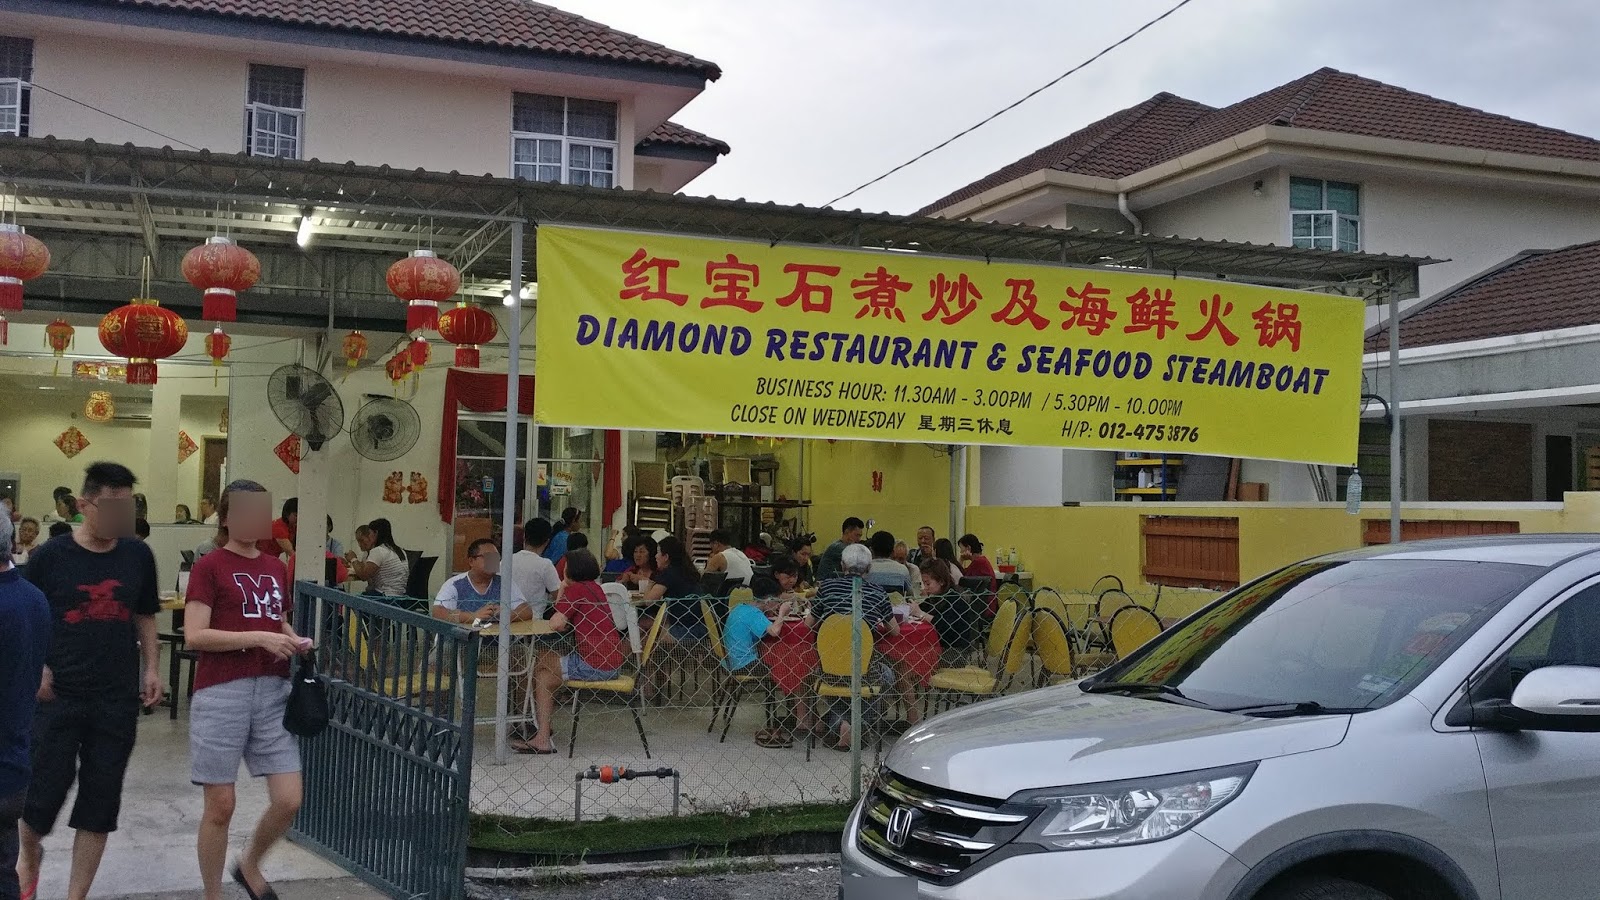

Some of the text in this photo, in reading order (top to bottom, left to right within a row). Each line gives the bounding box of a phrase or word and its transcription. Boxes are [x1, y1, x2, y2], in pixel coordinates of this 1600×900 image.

[620, 249, 1302, 352] 红宝石煮炒及海鲜火锅
[576, 315, 1330, 395] DIAMOND RESTAURANT & SEAFOOD STEAMBOAT
[756, 377, 834, 399] BUSINESS
[838, 382, 887, 402] HOUR:
[894, 385, 957, 405] 11.30AM
[973, 388, 1032, 409] 3.00PM
[1053, 393, 1110, 413] 5.30PM
[1126, 397, 1183, 417] 10.00PM
[731, 404, 778, 424] CLOSE
[783, 406, 808, 425] ON
[812, 408, 906, 430] WEDNESDAY
[917, 414, 1014, 436] 星期三休息
[1061, 420, 1094, 439] H/P:
[556, 472, 573, 482] OPEN
